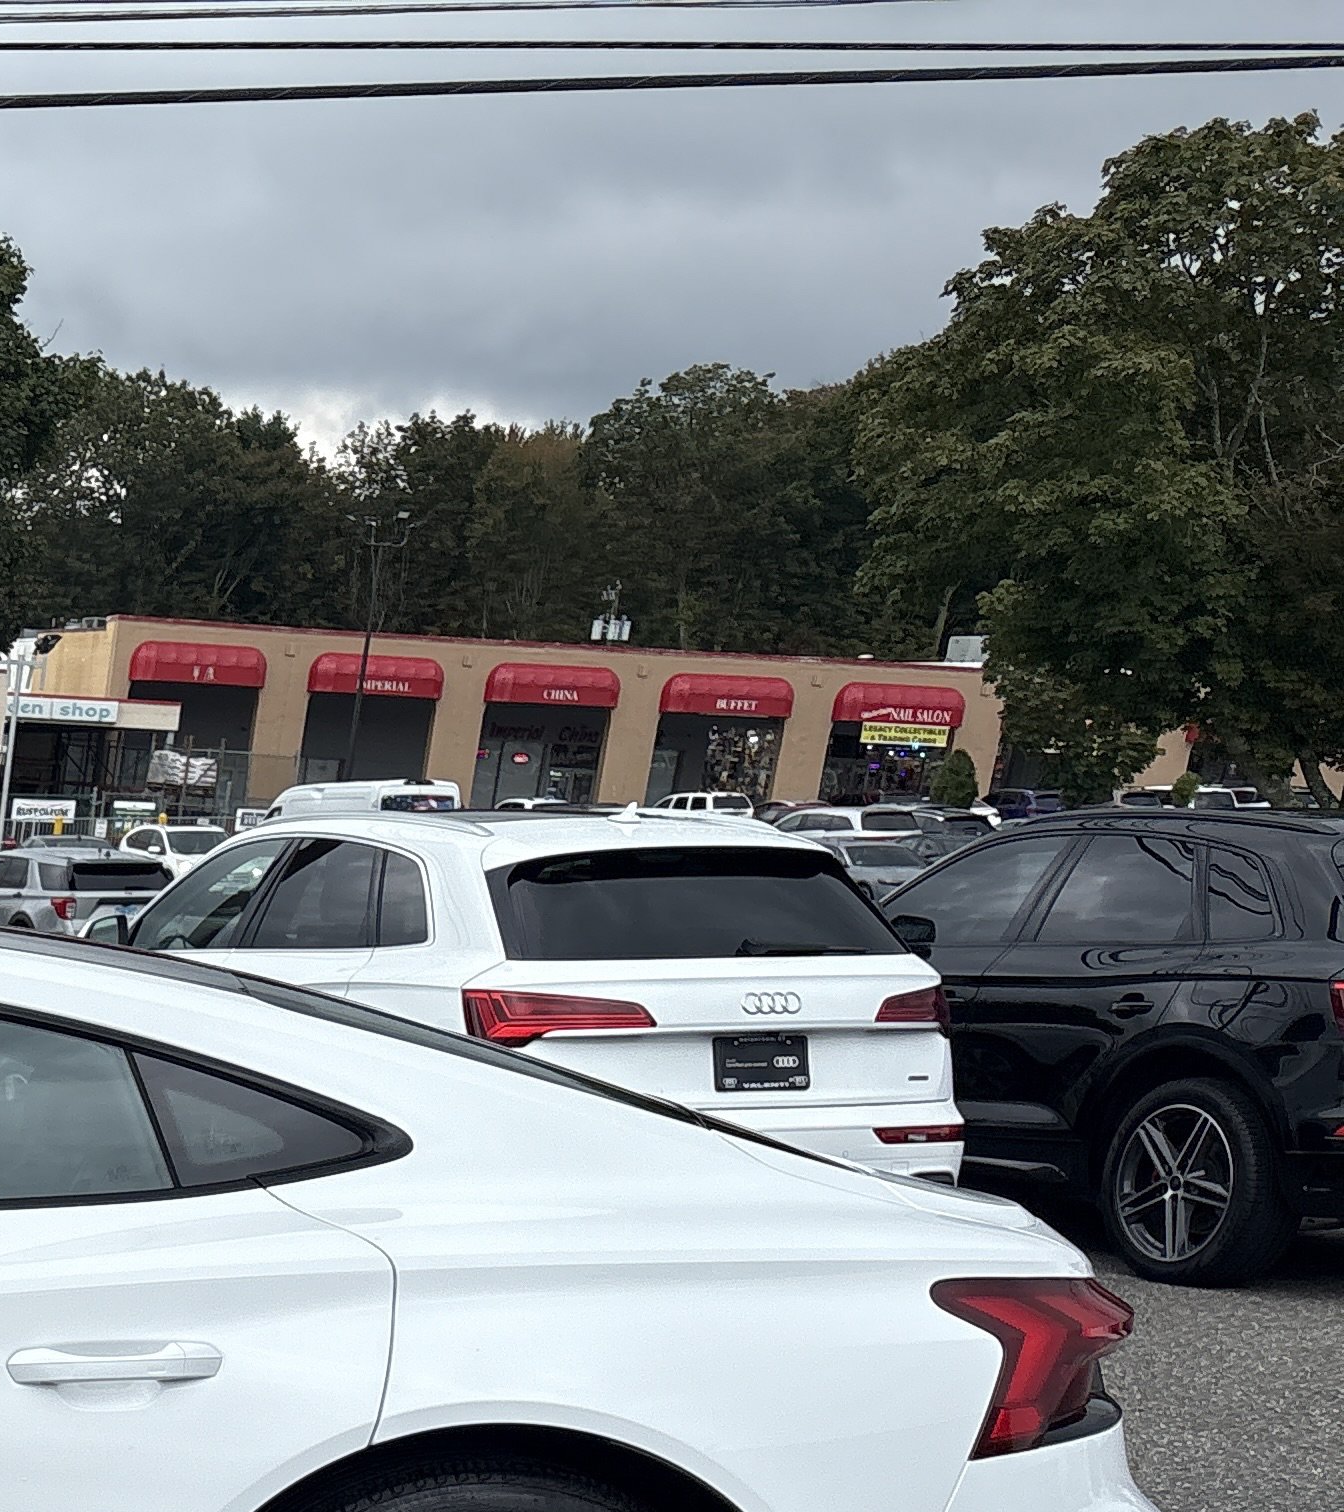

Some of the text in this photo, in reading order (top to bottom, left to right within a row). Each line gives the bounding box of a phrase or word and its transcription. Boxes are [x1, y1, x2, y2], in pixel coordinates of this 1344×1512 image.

[542, 688, 579, 701] CHINA
[715, 698, 759, 711] BUFFET
[59, 702, 111, 723] shop
[888, 707, 915, 722] NAIL
[915, 708, 953, 724] SALON
